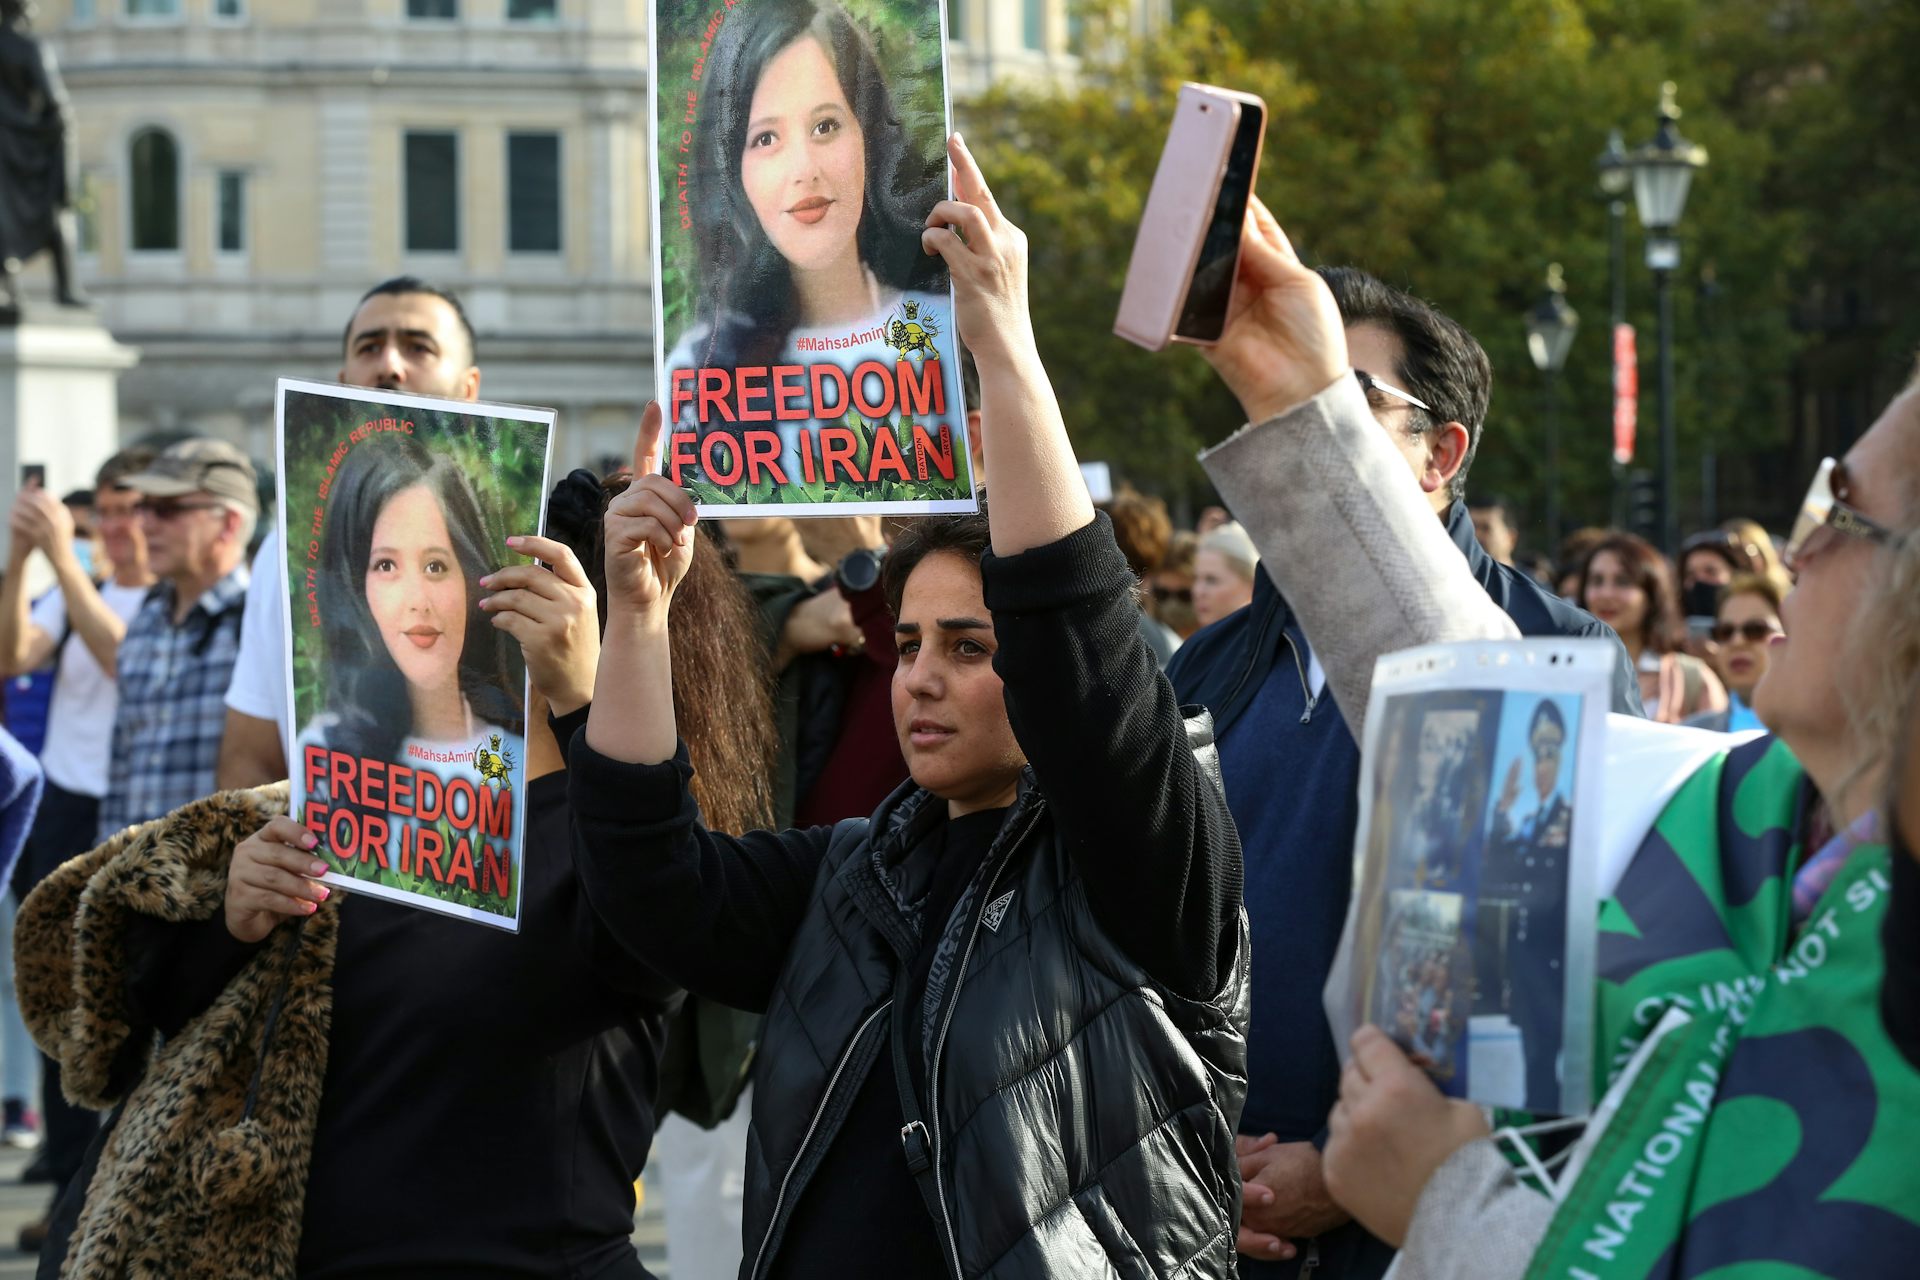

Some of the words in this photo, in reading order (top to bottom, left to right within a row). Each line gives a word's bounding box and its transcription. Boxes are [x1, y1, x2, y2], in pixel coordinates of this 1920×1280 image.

[691, 9, 724, 80] ISLAMIC
[684, 91, 697, 124] THE
[680, 130, 692, 153] TO
[679, 163, 692, 230] DEATH
[671, 360, 945, 423] FREEDOM
[348, 418, 415, 445] REPUBLIC
[671, 431, 788, 486] FOR
[800, 425, 955, 483] IRAN
[915, 437, 927, 479] FRAYDON
[318, 440, 349, 500] ISLAMIC
[308, 540, 319, 560] TO
[311, 504, 324, 536] THE
[307, 567, 321, 628] DEATH
[304, 745, 512, 841] FREEDOM
[305, 800, 390, 868] FOR
[401, 825, 510, 897] IRAN
[1777, 907, 1841, 985] NOT
[1845, 867, 1891, 913] SI
